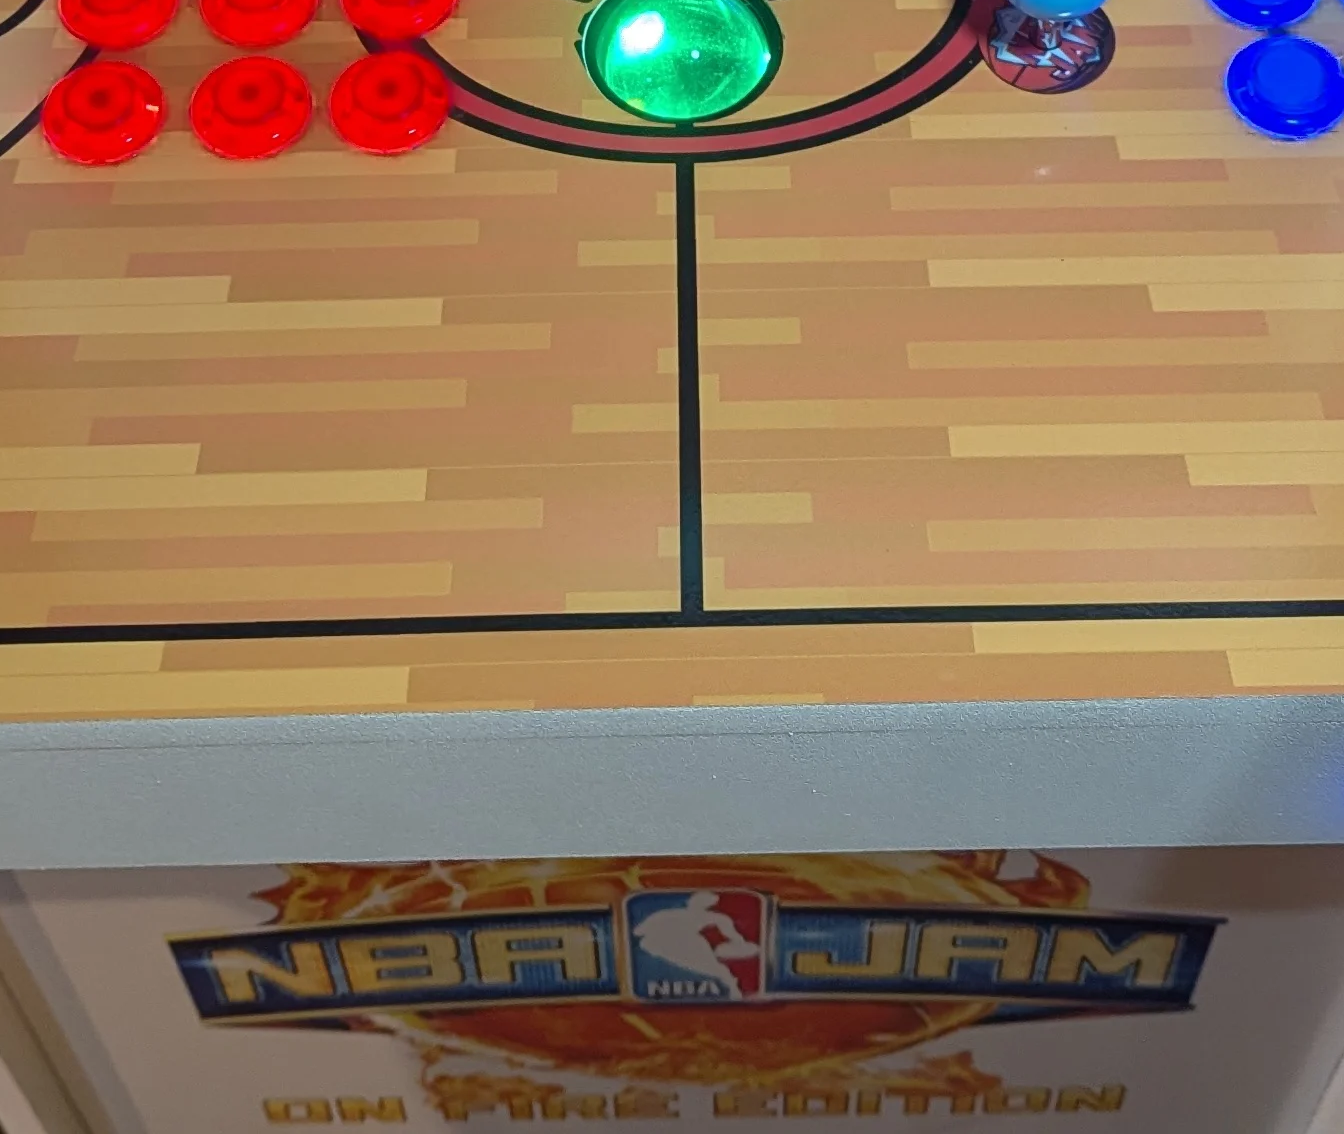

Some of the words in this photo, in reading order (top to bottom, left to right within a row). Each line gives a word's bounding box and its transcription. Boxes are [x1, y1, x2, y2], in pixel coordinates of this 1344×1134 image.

[210, 924, 603, 1005] NBA
[792, 918, 1181, 988] JAM
[646, 979, 720, 997] NBA
[263, 1097, 407, 1122] ON
[712, 1084, 1128, 1119] EDITION
